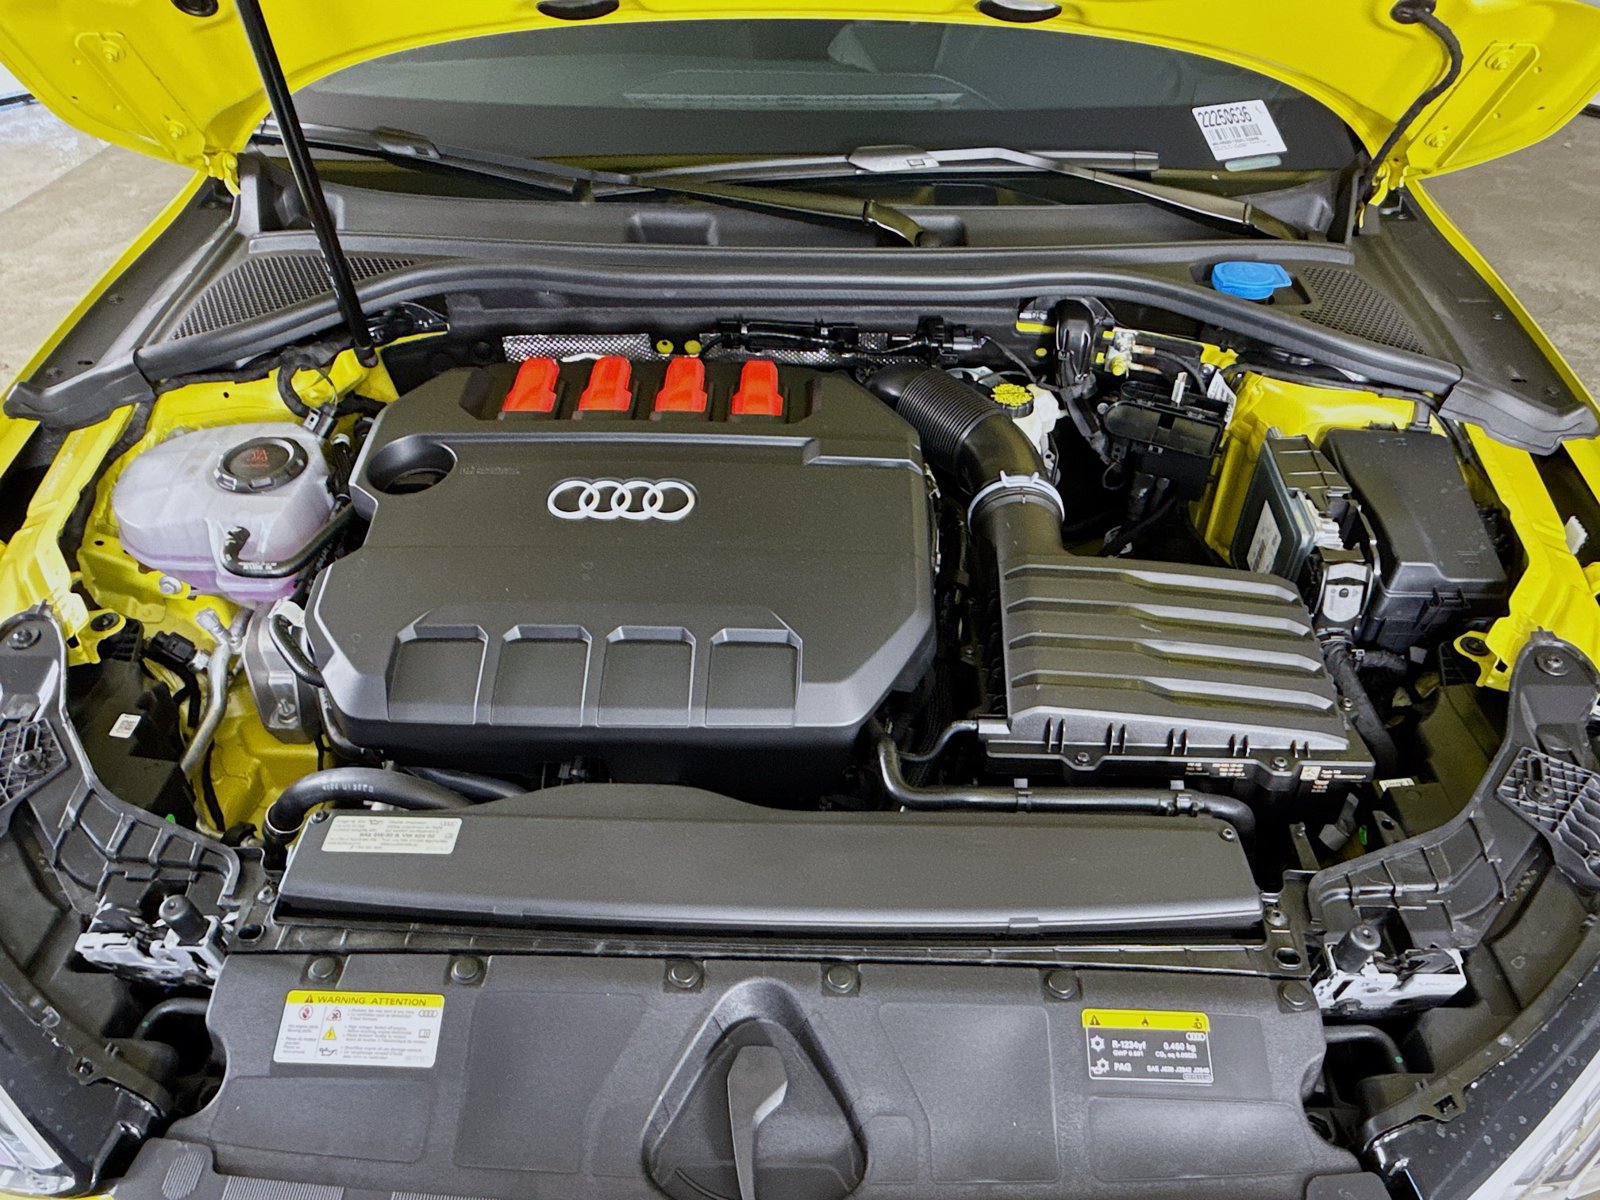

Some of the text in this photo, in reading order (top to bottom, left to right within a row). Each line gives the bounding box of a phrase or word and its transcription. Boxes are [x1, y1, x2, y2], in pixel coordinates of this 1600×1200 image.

[1198, 106, 1252, 128] 22250636
[317, 996, 427, 1006] WARNING ATTENTION
[1111, 1040, 1146, 1050] R-1234yf
[1186, 1043, 1196, 1053] kg
[1114, 1062, 1132, 1072] PAG
